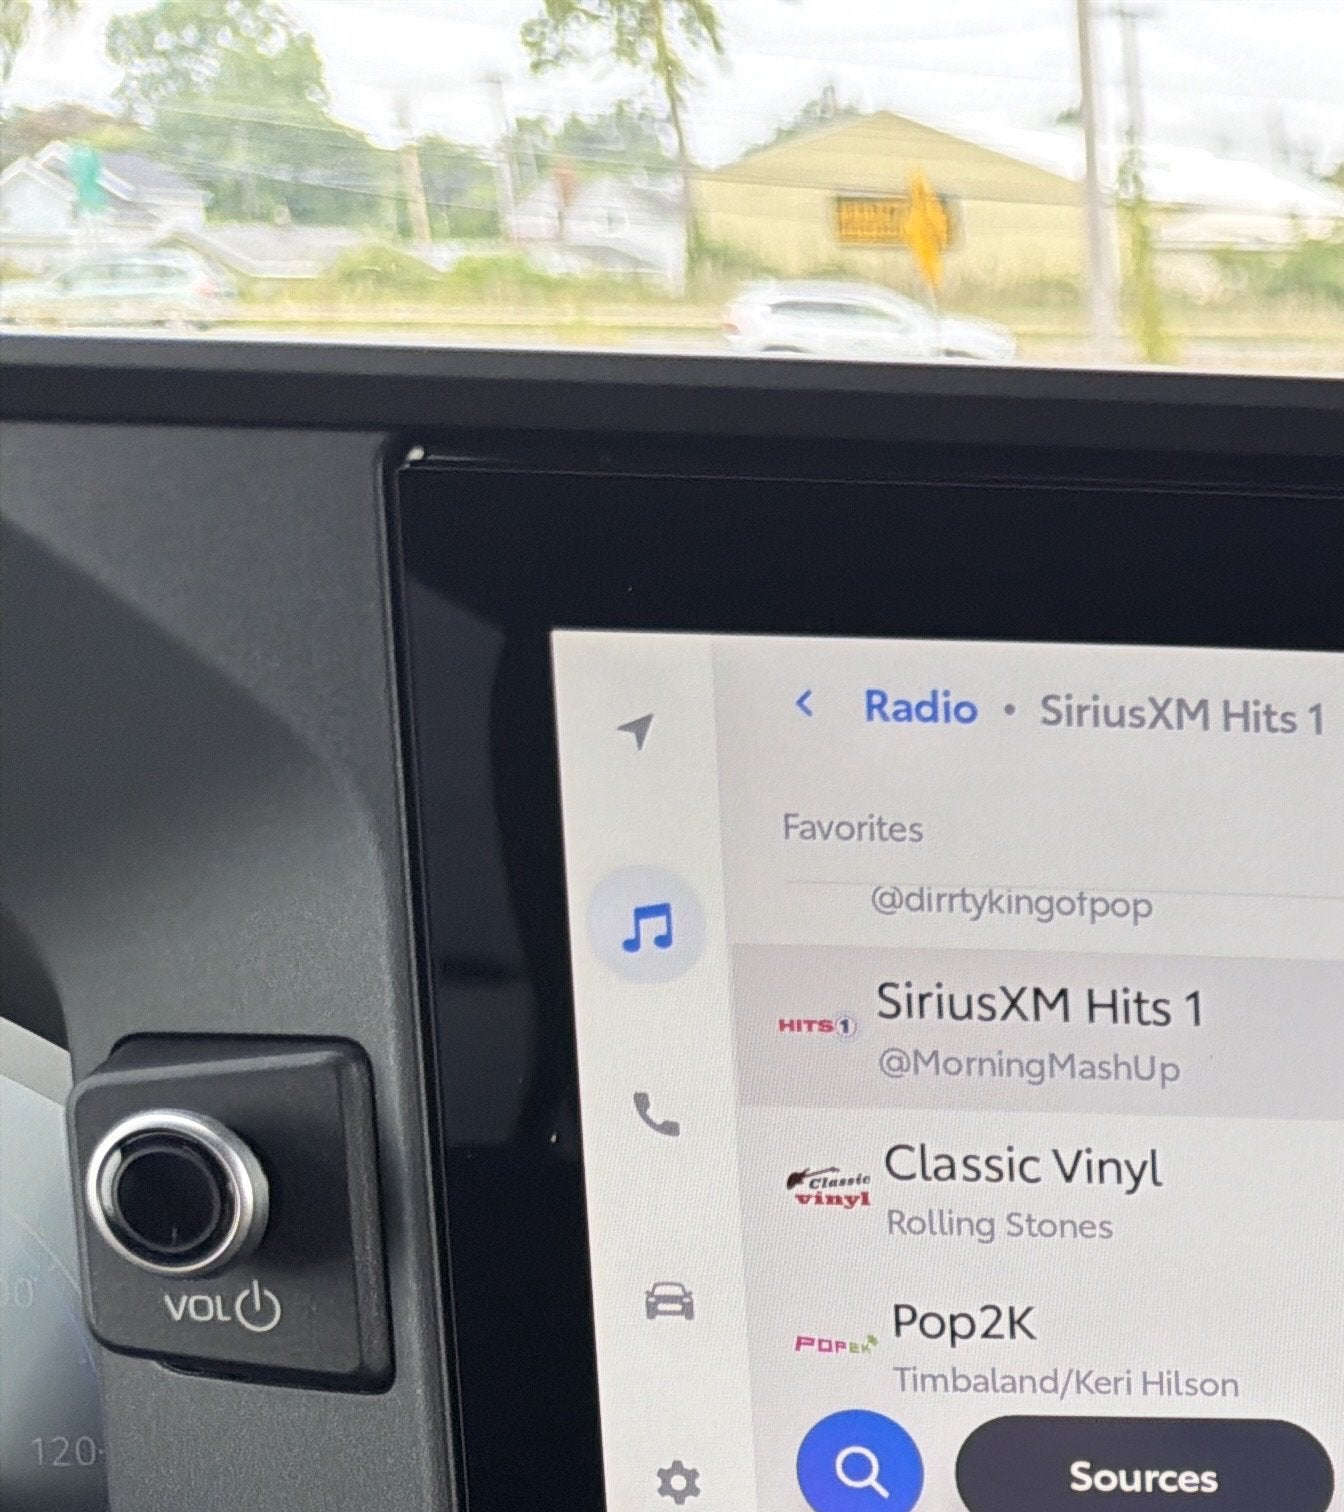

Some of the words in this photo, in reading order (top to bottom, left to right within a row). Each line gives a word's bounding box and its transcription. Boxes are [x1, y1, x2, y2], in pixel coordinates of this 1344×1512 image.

[865, 688, 978, 724] Radio
[1040, 692, 1210, 732] SiriusXM
[1222, 698, 1298, 734] Hits
[1308, 702, 1323, 736] 1
[783, 812, 924, 843] Favorites
[877, 980, 1070, 1023] SiriusXM
[1087, 986, 1172, 1027] Hits
[1185, 990, 1201, 1027] 1
[778, 1018, 835, 1033] HITS
[878, 1046, 1181, 1090] @MorningMashUp
[885, 1142, 1042, 1184] Classic
[1051, 1147, 1163, 1196] Vinyl
[887, 1208, 996, 1245] Rolling
[1005, 1211, 1114, 1240] Stones
[164, 1294, 232, 1322] VOL
[893, 1303, 1037, 1349] Pop2K
[892, 1365, 1132, 1401] Timbaland/Keri
[1142, 1369, 1239, 1398] Hilson
[32, 1434, 96, 1468] 120
[1070, 1460, 1219, 1493] Sources
